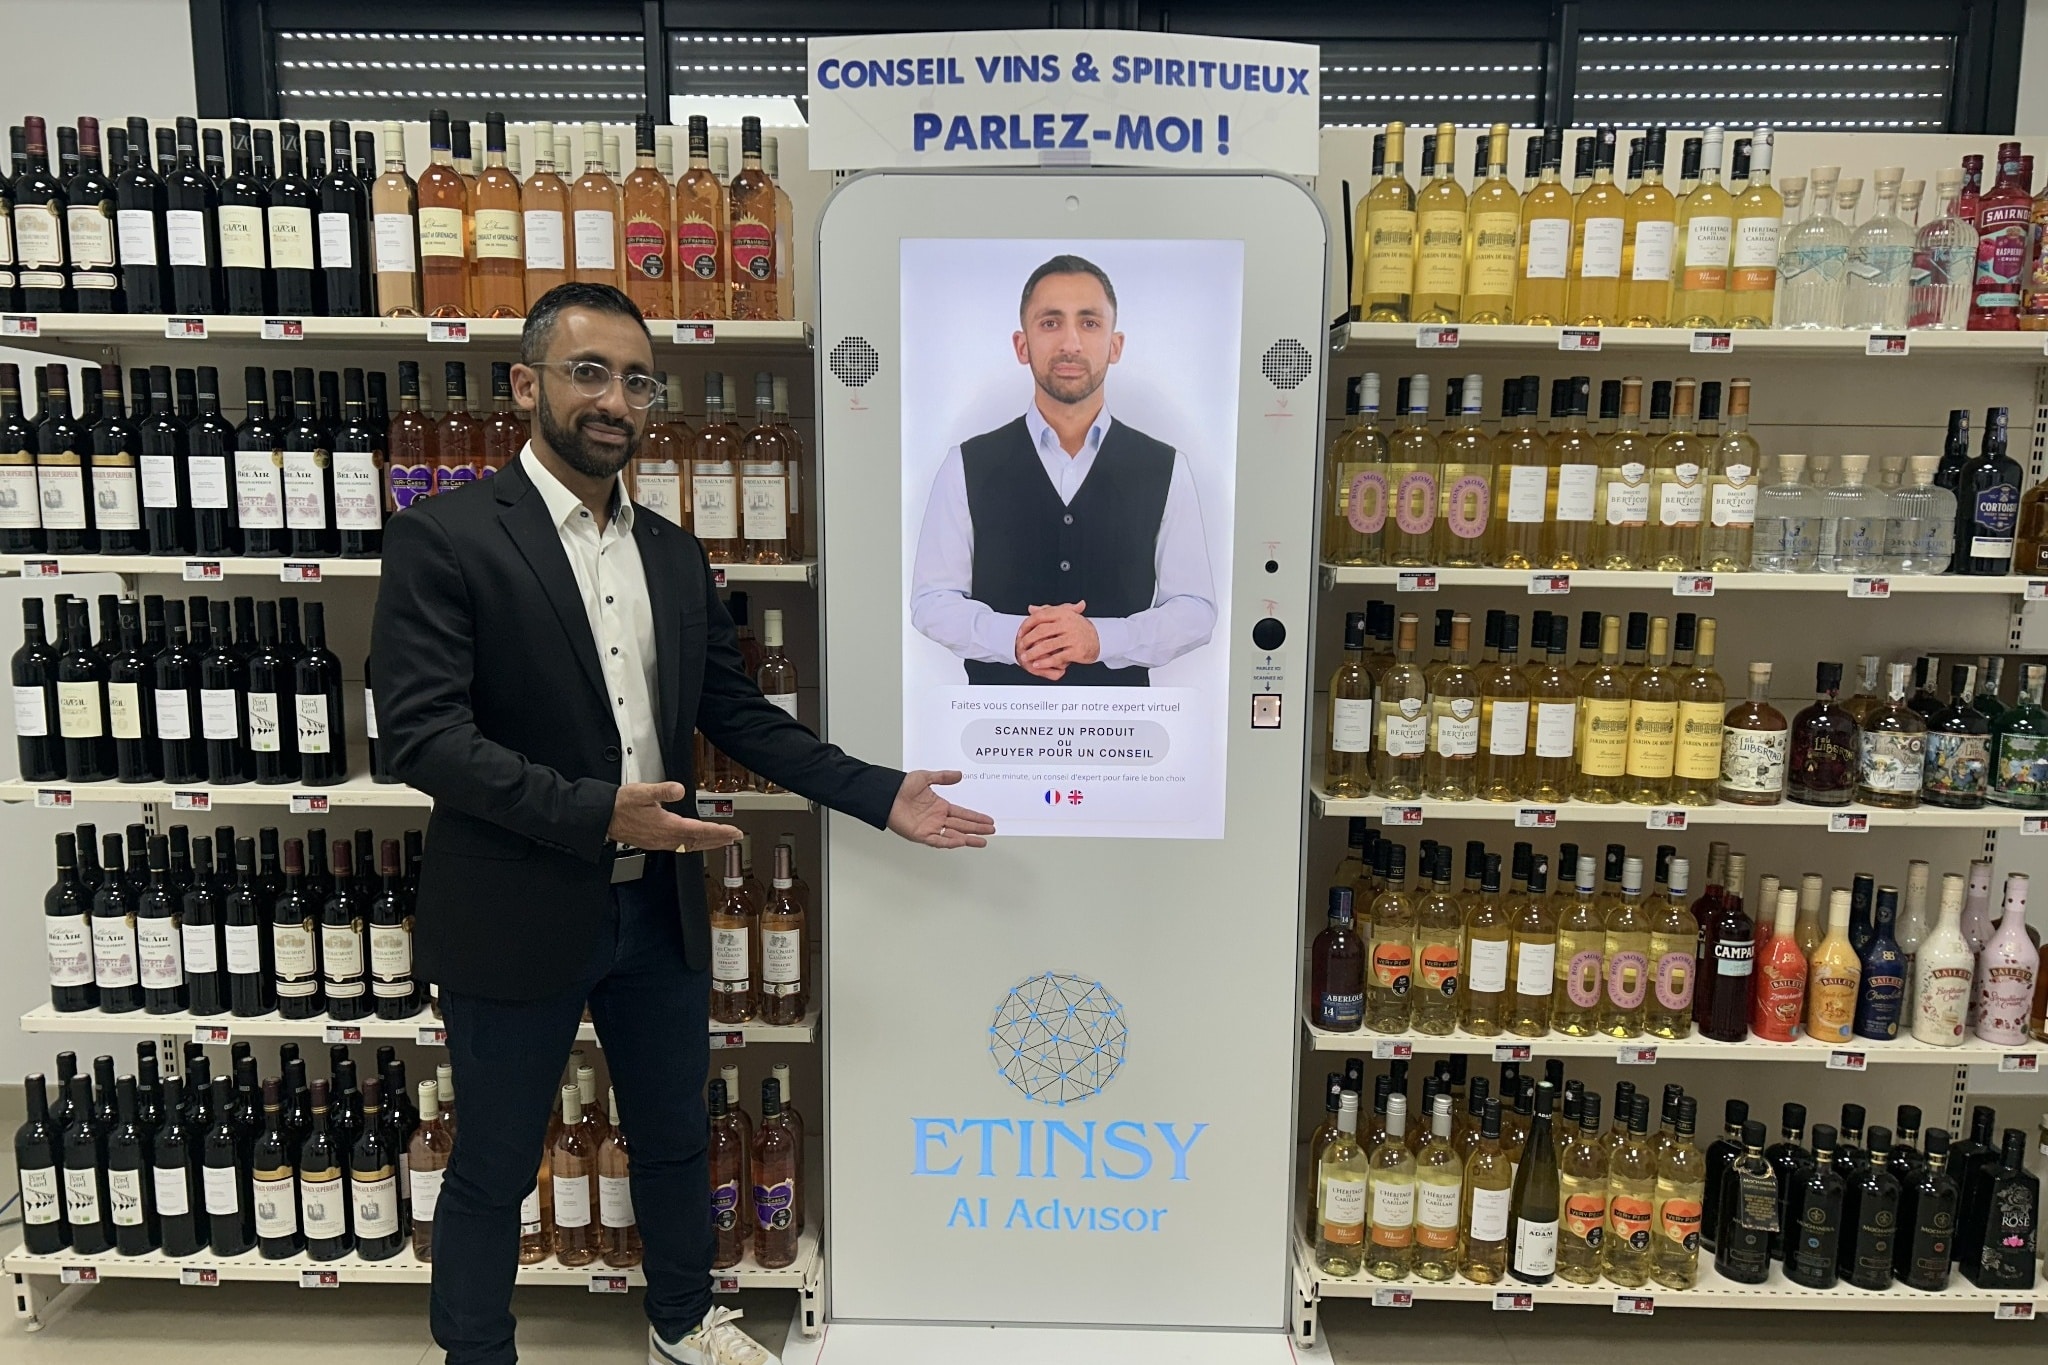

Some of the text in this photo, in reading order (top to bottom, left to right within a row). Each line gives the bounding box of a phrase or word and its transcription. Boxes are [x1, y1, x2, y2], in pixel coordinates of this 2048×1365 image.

[817, 52, 1310, 97] CONSEIL VINS & SPIRITUEUX
[913, 112, 1203, 153] PARLEZ-MOI
[951, 700, 1181, 717] Faites vous conseiller par notre expert virtuel
[994, 726, 1135, 740] SCANNEZ UN PRODUIT
[1057, 739, 1072, 747] ou
[975, 747, 1154, 761] APPUYER POUR UN CONSEIL
[963, 772, 978, 780] oins
[979, 772, 1001, 781] d'une
[1032, 774, 1042, 782] un
[1043, 773, 1069, 782] conseil
[1070, 773, 1102, 785] d'expert
[1103, 776, 1121, 786] pour
[1122, 774, 1140, 784] faire
[1141, 774, 1148, 784] le
[1150, 775, 1165, 785] bon
[1166, 775, 1186, 786] choix
[1934, 969, 1971, 980] BAILEYS
[1992, 968, 2032, 980] BAILEYS
[1823, 979, 1855, 989] BAILEYS
[1323, 1006, 1334, 1016] 14
[909, 1117, 1210, 1182] ETINSY
[946, 1197, 1168, 1233] AI Advisor
[2002, 1216, 2030, 1228] ROSE
[1528, 1230, 1553, 1238] ADAM
